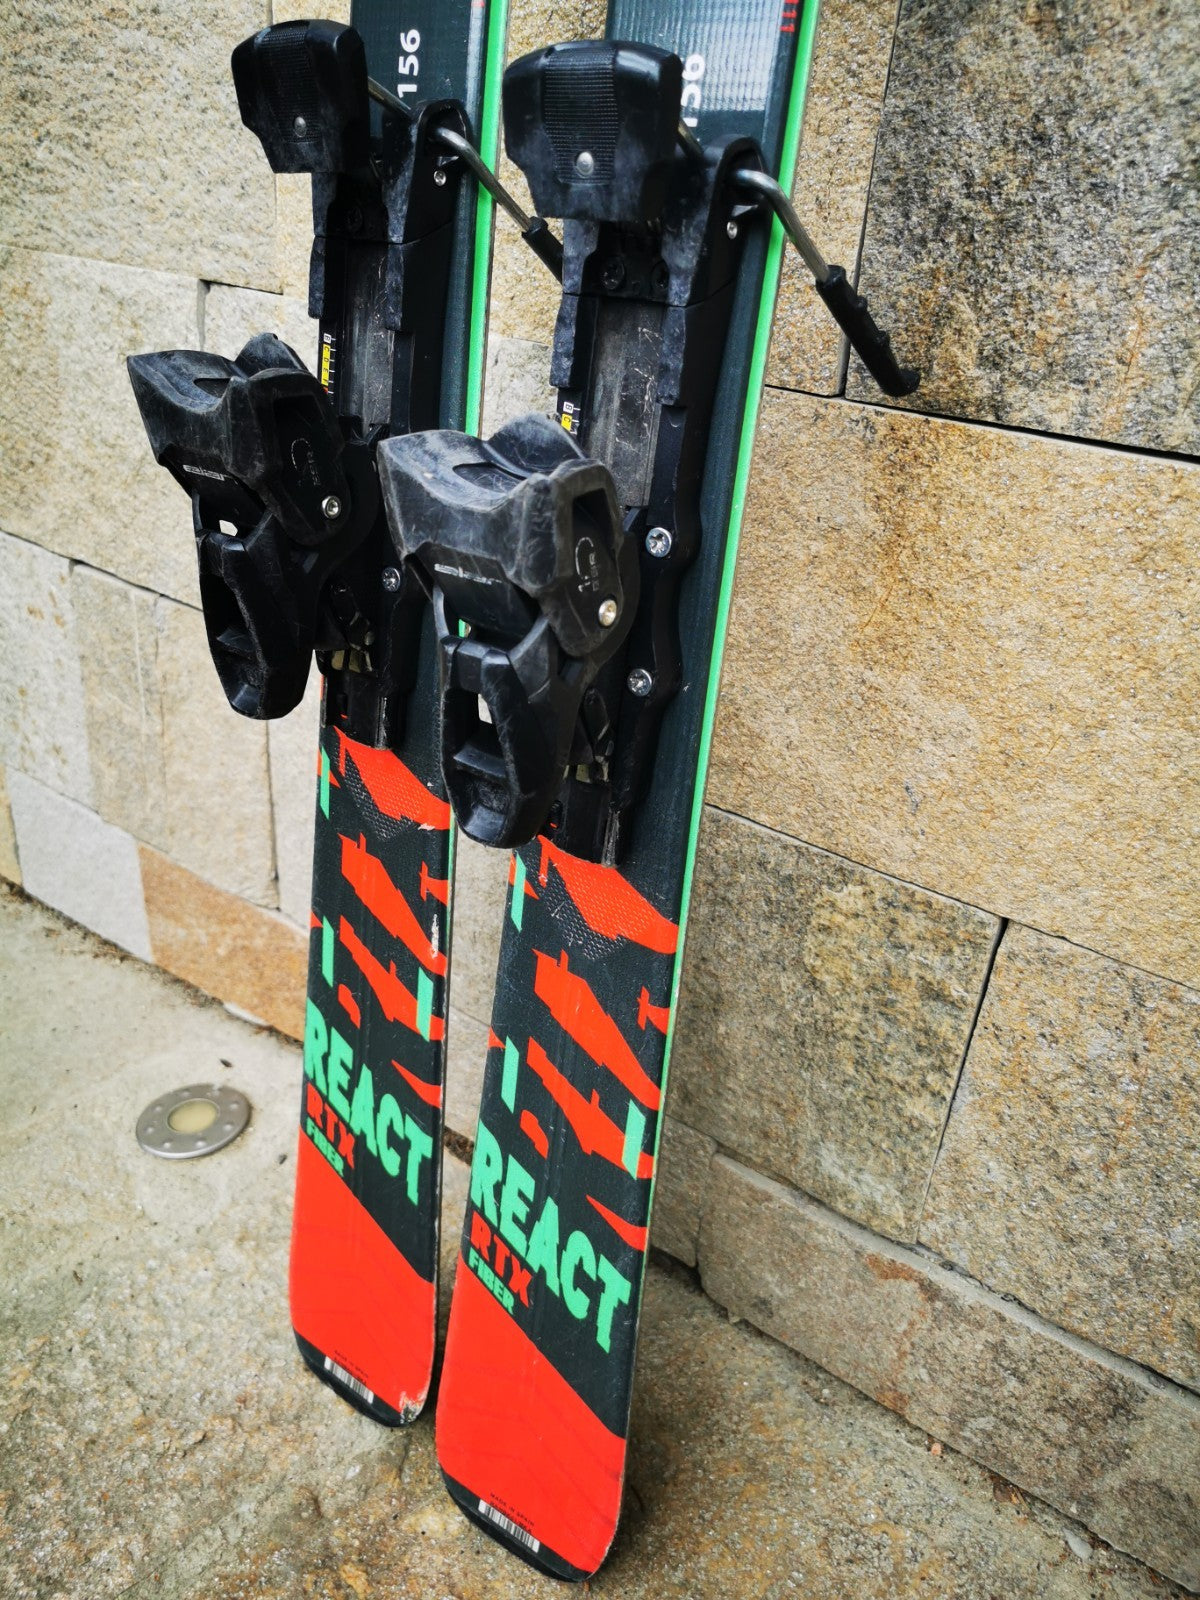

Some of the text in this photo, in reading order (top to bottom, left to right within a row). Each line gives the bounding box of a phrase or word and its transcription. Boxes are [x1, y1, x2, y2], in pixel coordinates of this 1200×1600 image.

[397, 28, 421, 98] 156
[303, 996, 433, 1206] REACT
[306, 1081, 356, 1170] RTX
[468, 1246, 515, 1315] FIBER
[470, 1118, 632, 1354] REACT
[470, 1210, 533, 1309] RTX
